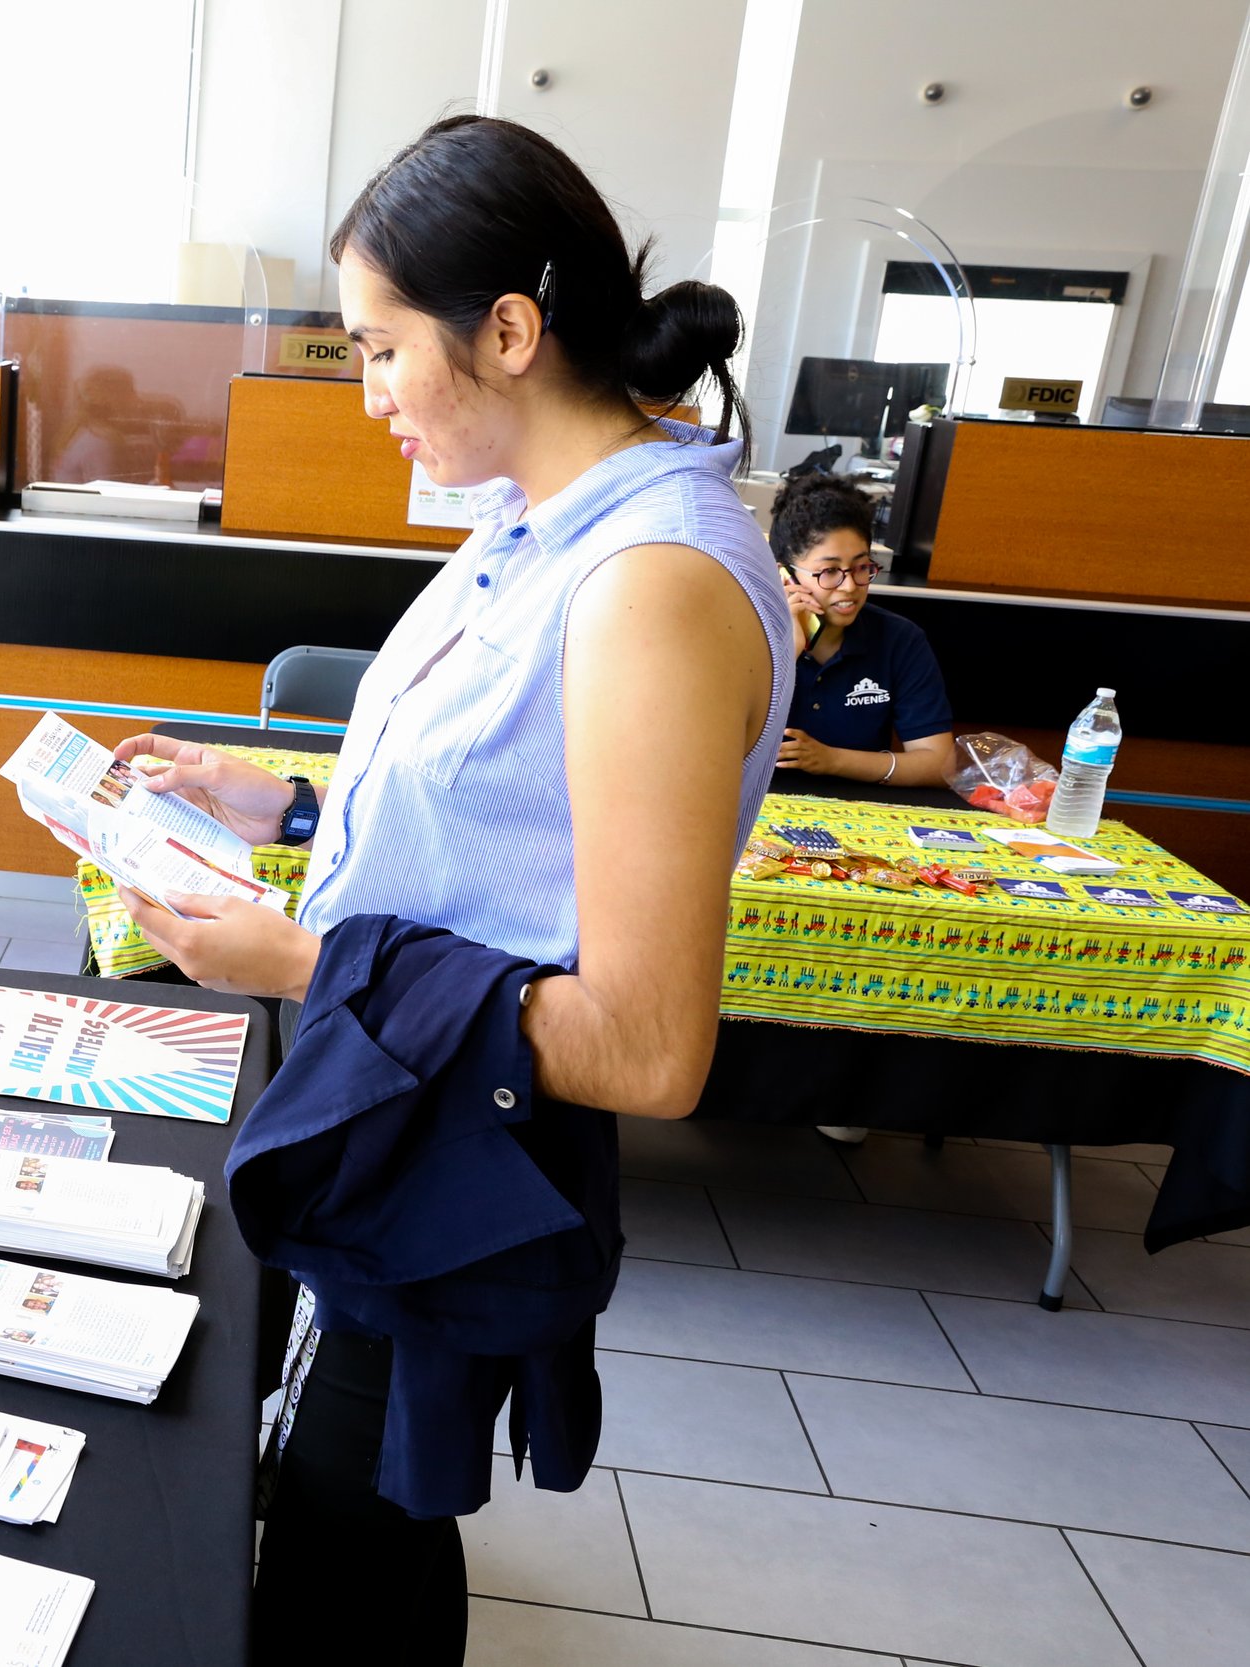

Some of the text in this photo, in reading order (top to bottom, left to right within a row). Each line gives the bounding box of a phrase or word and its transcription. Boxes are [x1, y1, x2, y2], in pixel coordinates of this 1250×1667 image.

[306, 344, 348, 360] FDIC
[1027, 387, 1075, 404] FDIC
[844, 693, 891, 706] JOVENES
[9, 1012, 64, 1074] HEALTH
[65, 1019, 110, 1079] MATTERS
